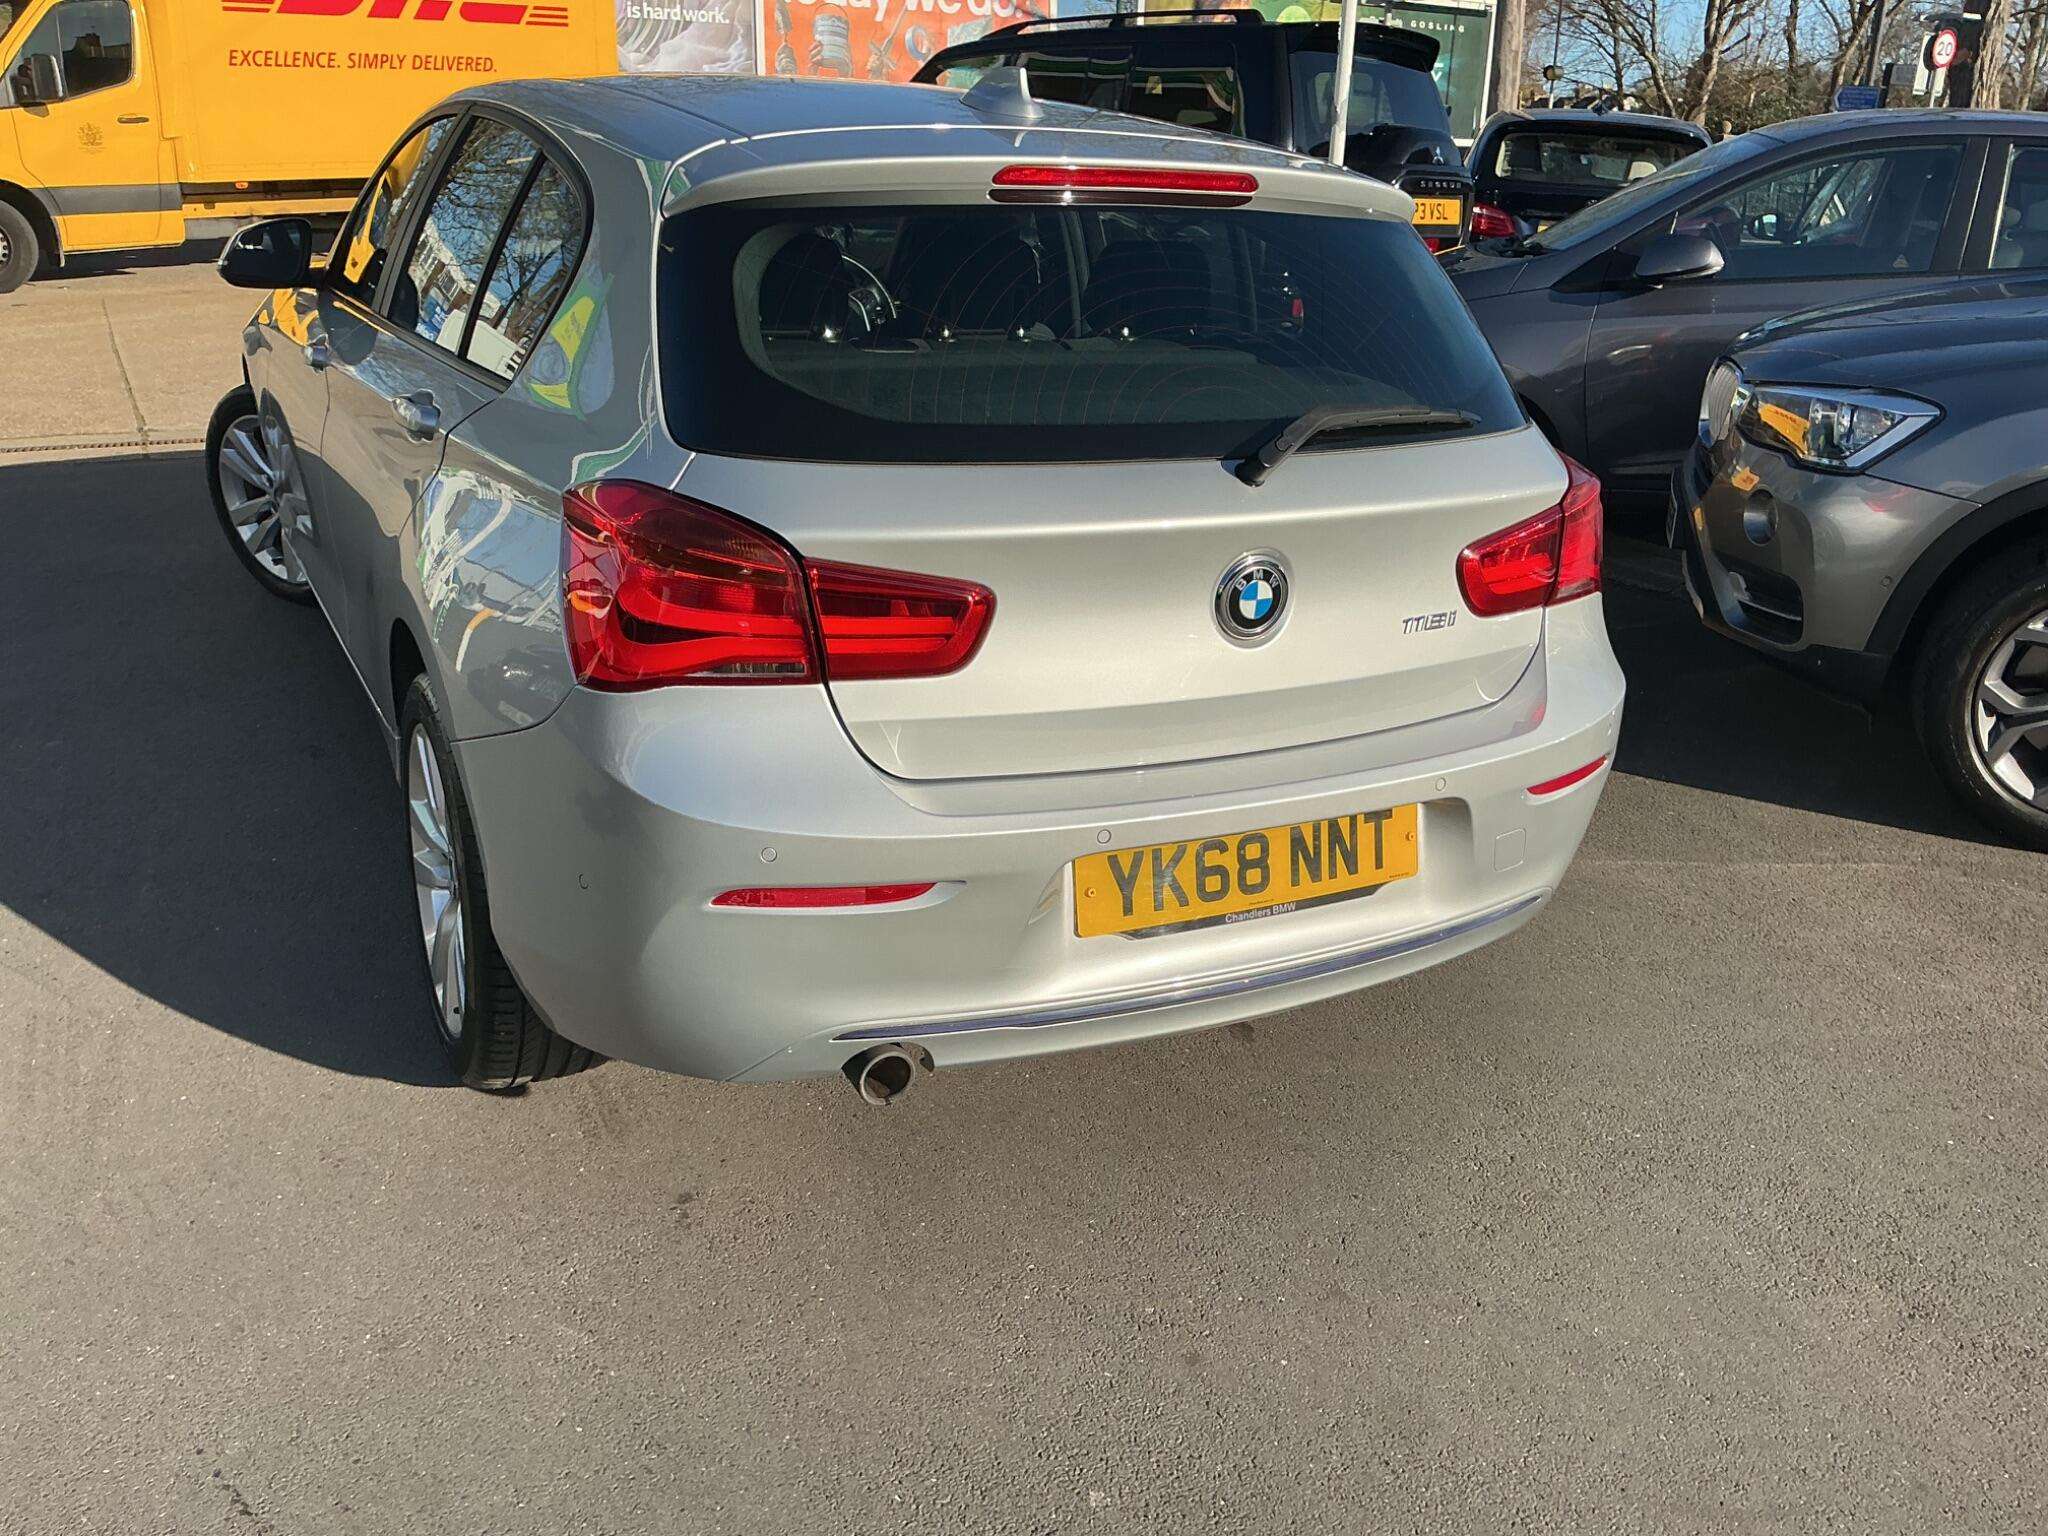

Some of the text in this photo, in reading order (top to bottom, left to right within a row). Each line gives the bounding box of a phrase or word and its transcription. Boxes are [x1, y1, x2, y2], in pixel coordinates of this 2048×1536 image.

[627, 1, 730, 23] is hard work.
[1938, 42, 1953, 56] 20
[228, 49, 498, 73] EXCELLENCE. SIMPLY DELIVERED.
[1429, 202, 1448, 220] VSL
[1235, 568, 1279, 591] BMW
[1107, 808, 1394, 917] YK68 NNT
[1225, 908, 1271, 924] Chandlers
[1272, 902, 1297, 916] BMW
